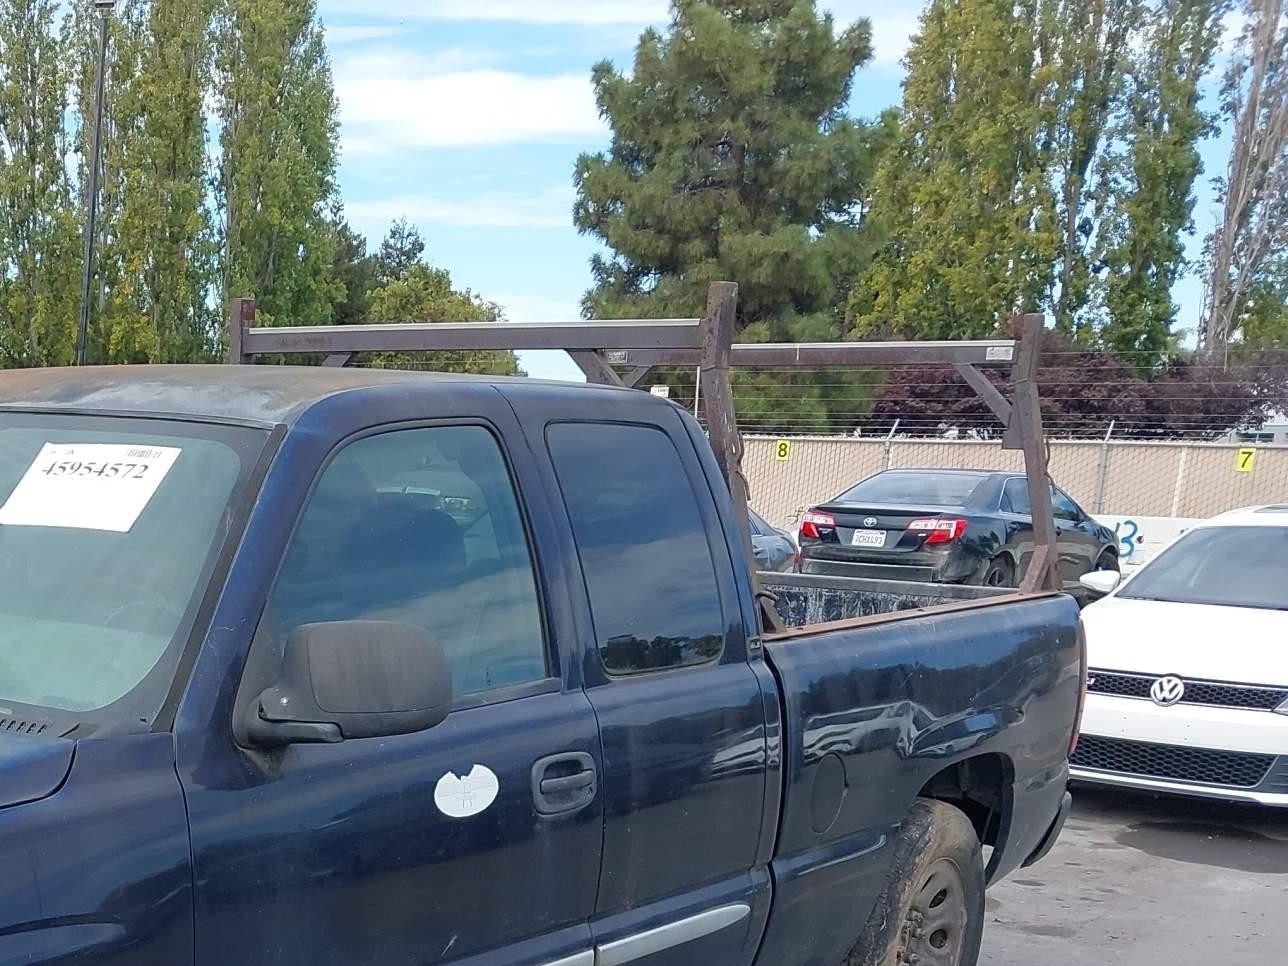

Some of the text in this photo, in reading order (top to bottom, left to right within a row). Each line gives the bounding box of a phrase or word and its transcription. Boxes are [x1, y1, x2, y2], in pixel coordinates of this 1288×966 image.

[777, 442, 788, 458] 8
[1241, 451, 1253, 468] 7
[42, 461, 149, 479] 45954572
